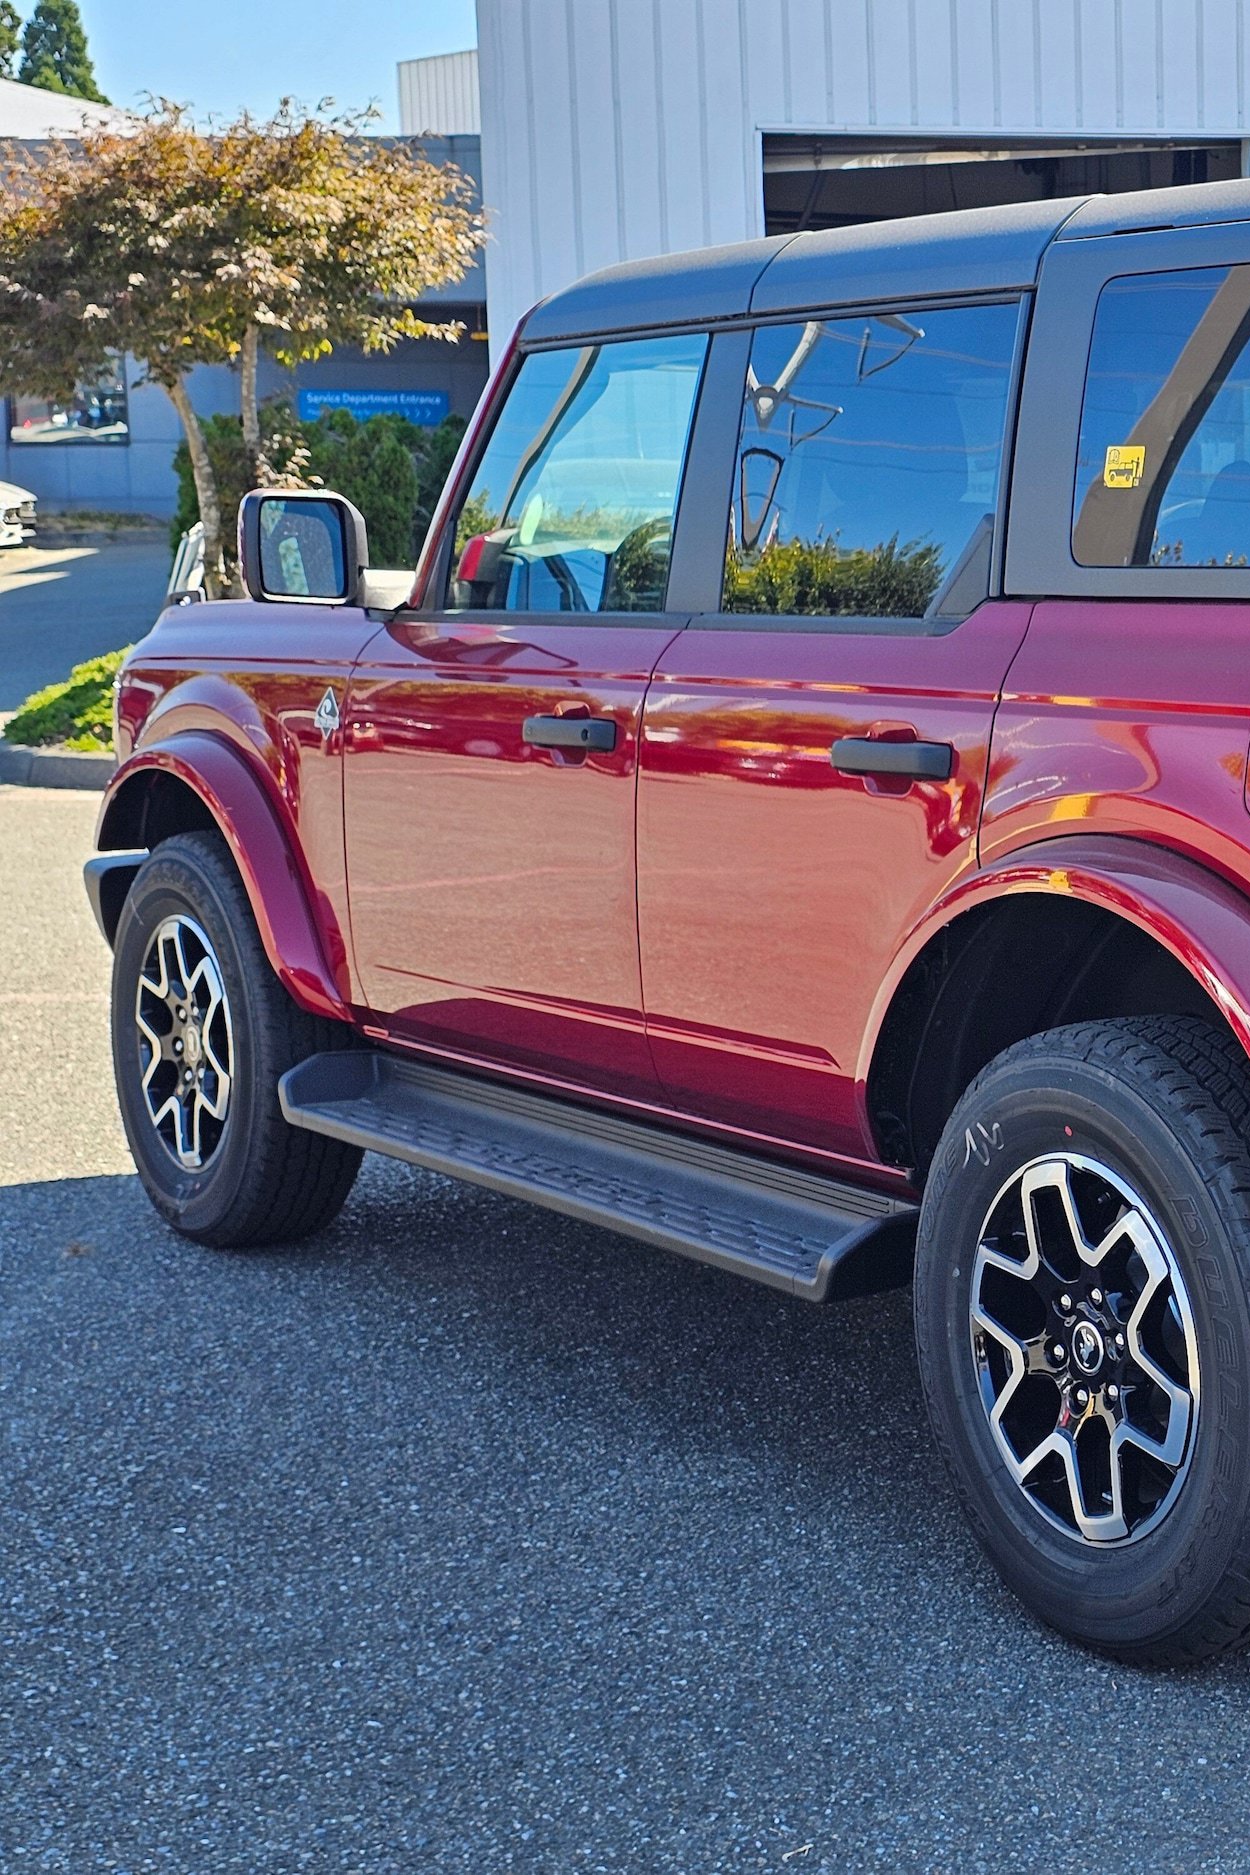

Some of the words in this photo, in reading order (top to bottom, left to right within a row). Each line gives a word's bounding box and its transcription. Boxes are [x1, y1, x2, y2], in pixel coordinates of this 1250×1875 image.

[307, 392, 340, 404] Service
[342, 392, 398, 405] Department
[400, 393, 441, 405] Entrance
